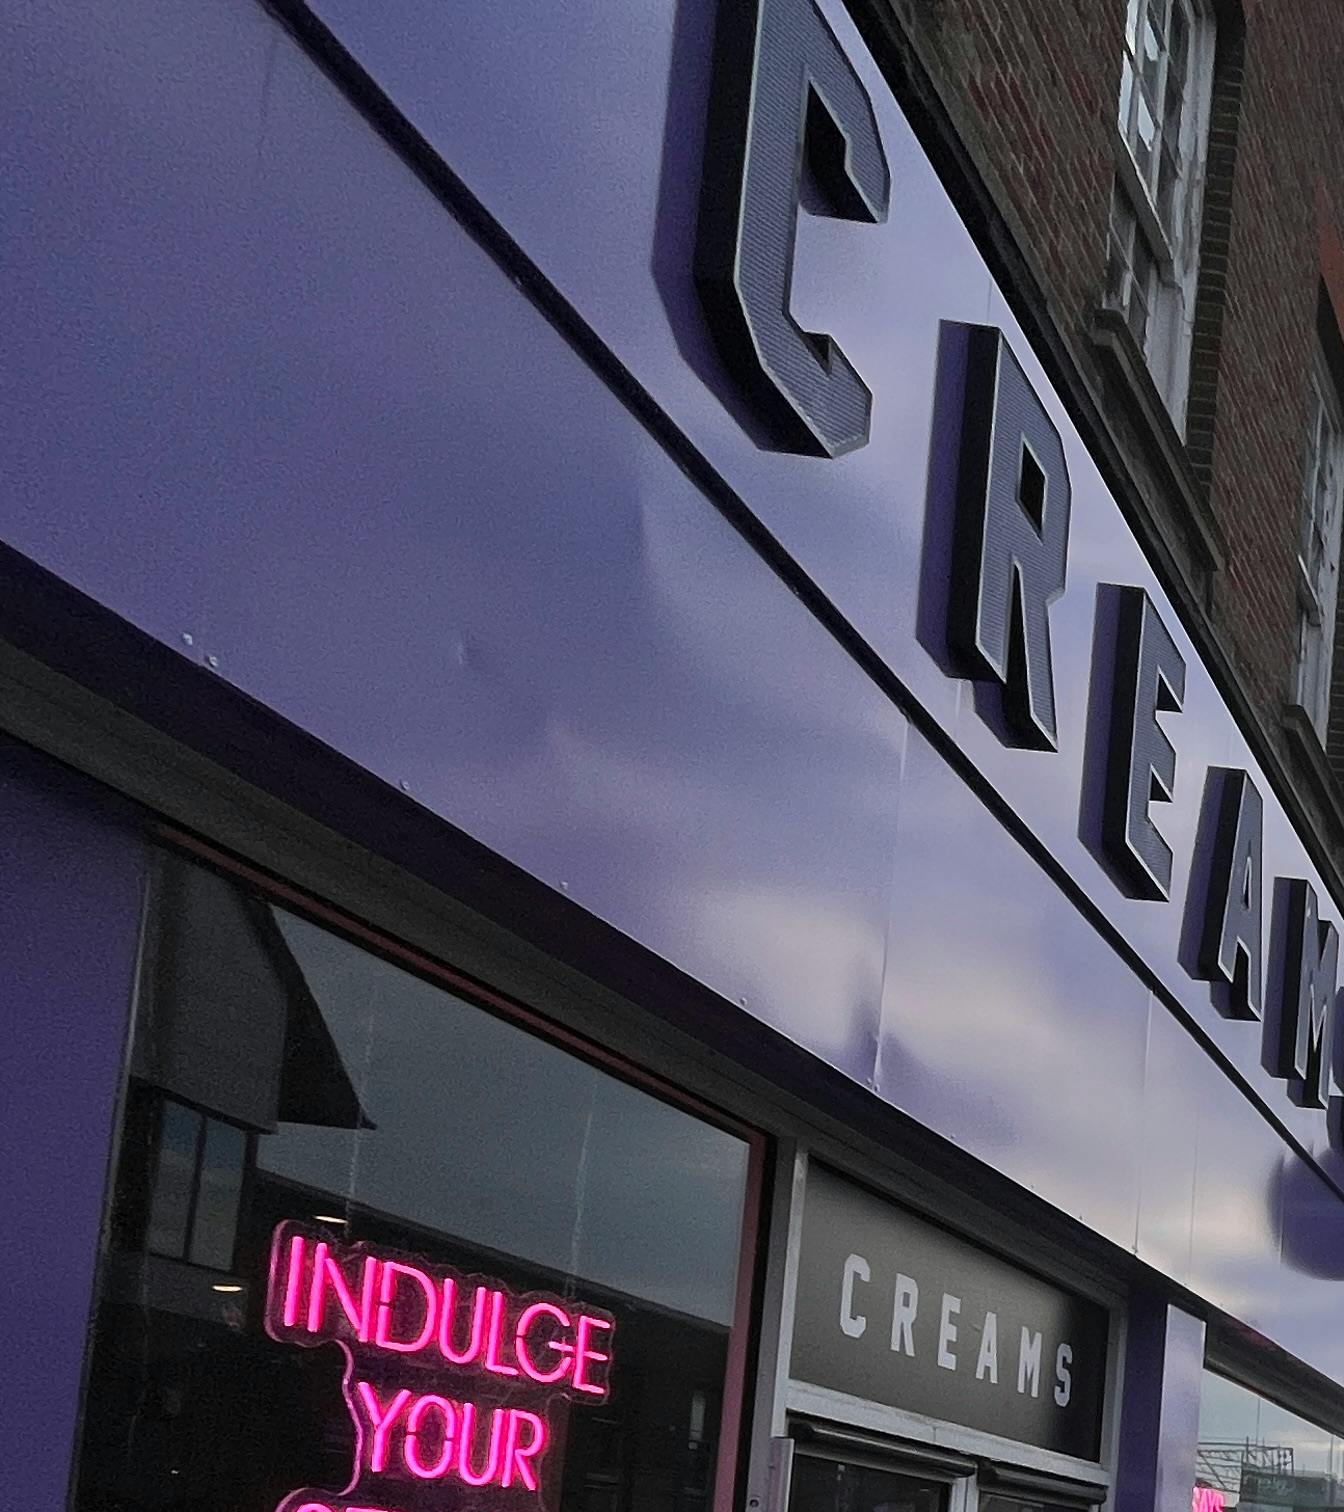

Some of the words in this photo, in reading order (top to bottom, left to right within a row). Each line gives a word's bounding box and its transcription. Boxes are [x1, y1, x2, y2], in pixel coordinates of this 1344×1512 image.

[283, 1236, 611, 1396] INDULGE
[840, 1253, 1073, 1408] CREAMS
[357, 1381, 546, 1491] YOUR
